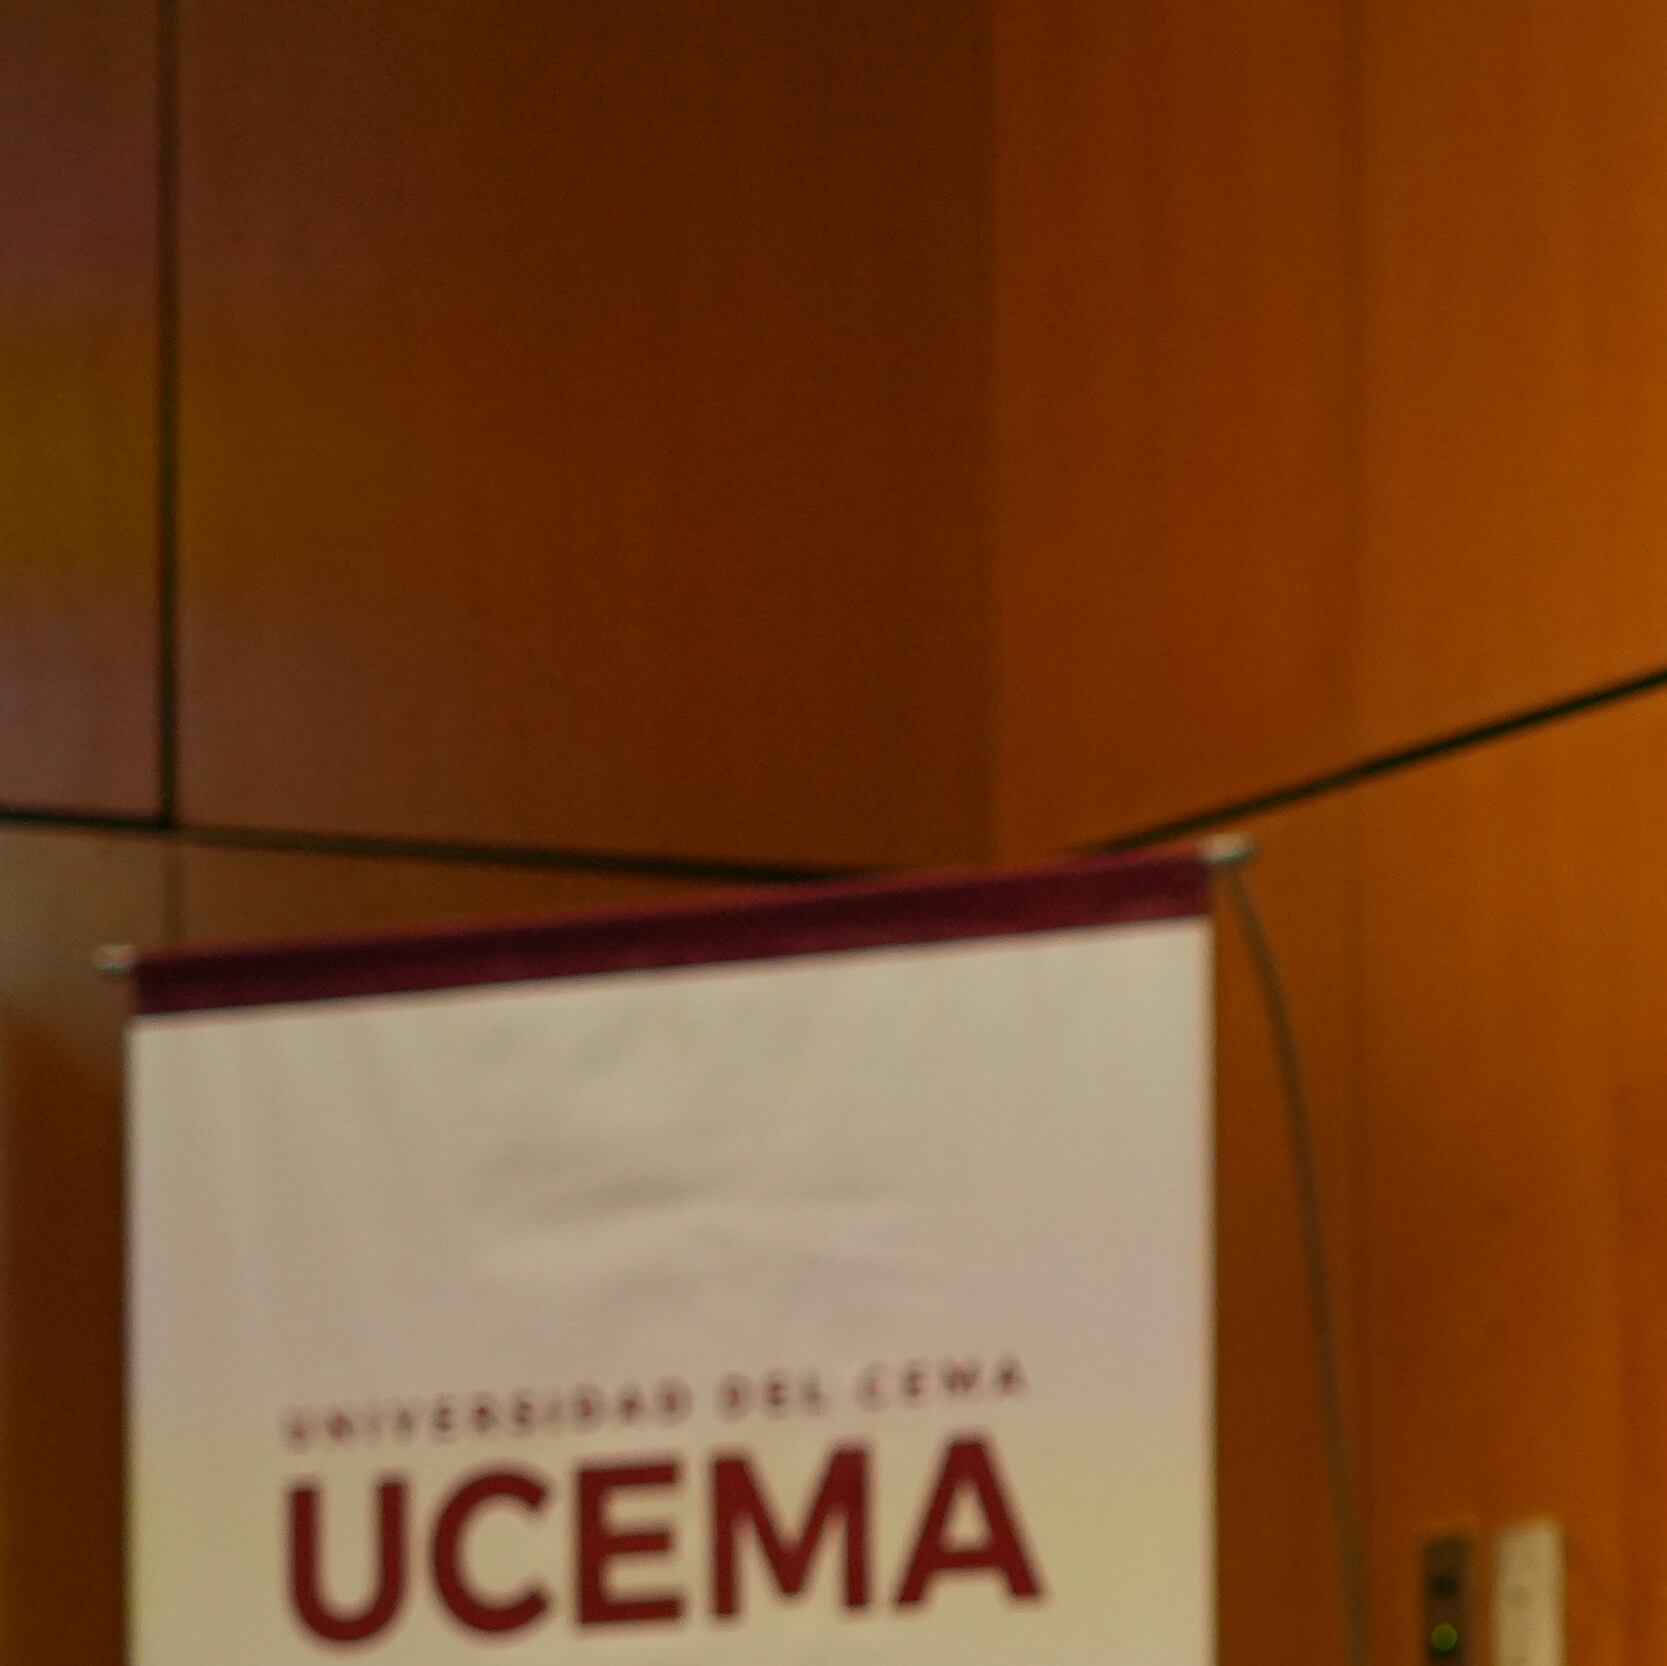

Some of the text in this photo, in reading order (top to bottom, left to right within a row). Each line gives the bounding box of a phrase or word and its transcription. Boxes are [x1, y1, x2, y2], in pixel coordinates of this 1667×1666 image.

[283, 1353, 1027, 1448] UNIVERSIDAD DEL CEMA
[286, 1432, 1044, 1646] UCEMA
